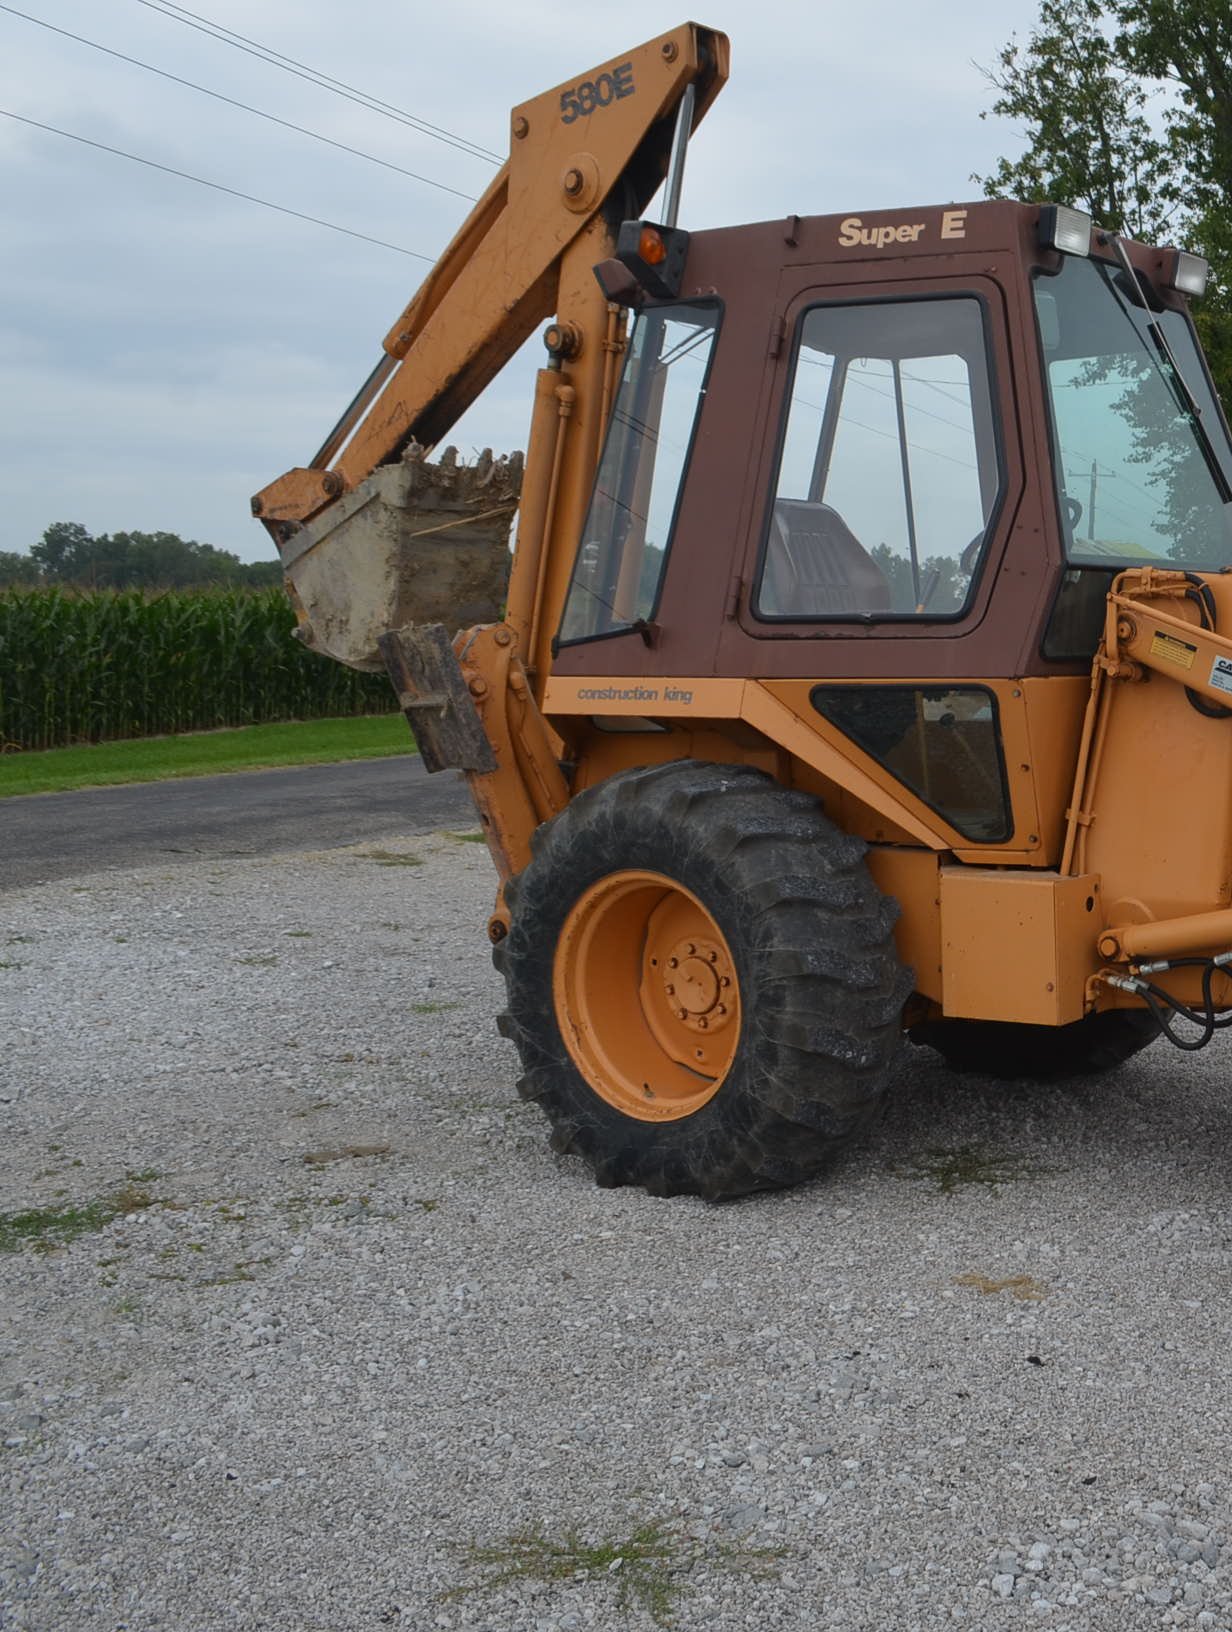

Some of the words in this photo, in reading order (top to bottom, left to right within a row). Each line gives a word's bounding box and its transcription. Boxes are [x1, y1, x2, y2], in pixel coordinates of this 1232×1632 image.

[561, 62, 635, 124] 580E
[838, 217, 926, 249] Super
[941, 210, 968, 239] E
[577, 686, 658, 701] construction
[664, 686, 693, 705] king
